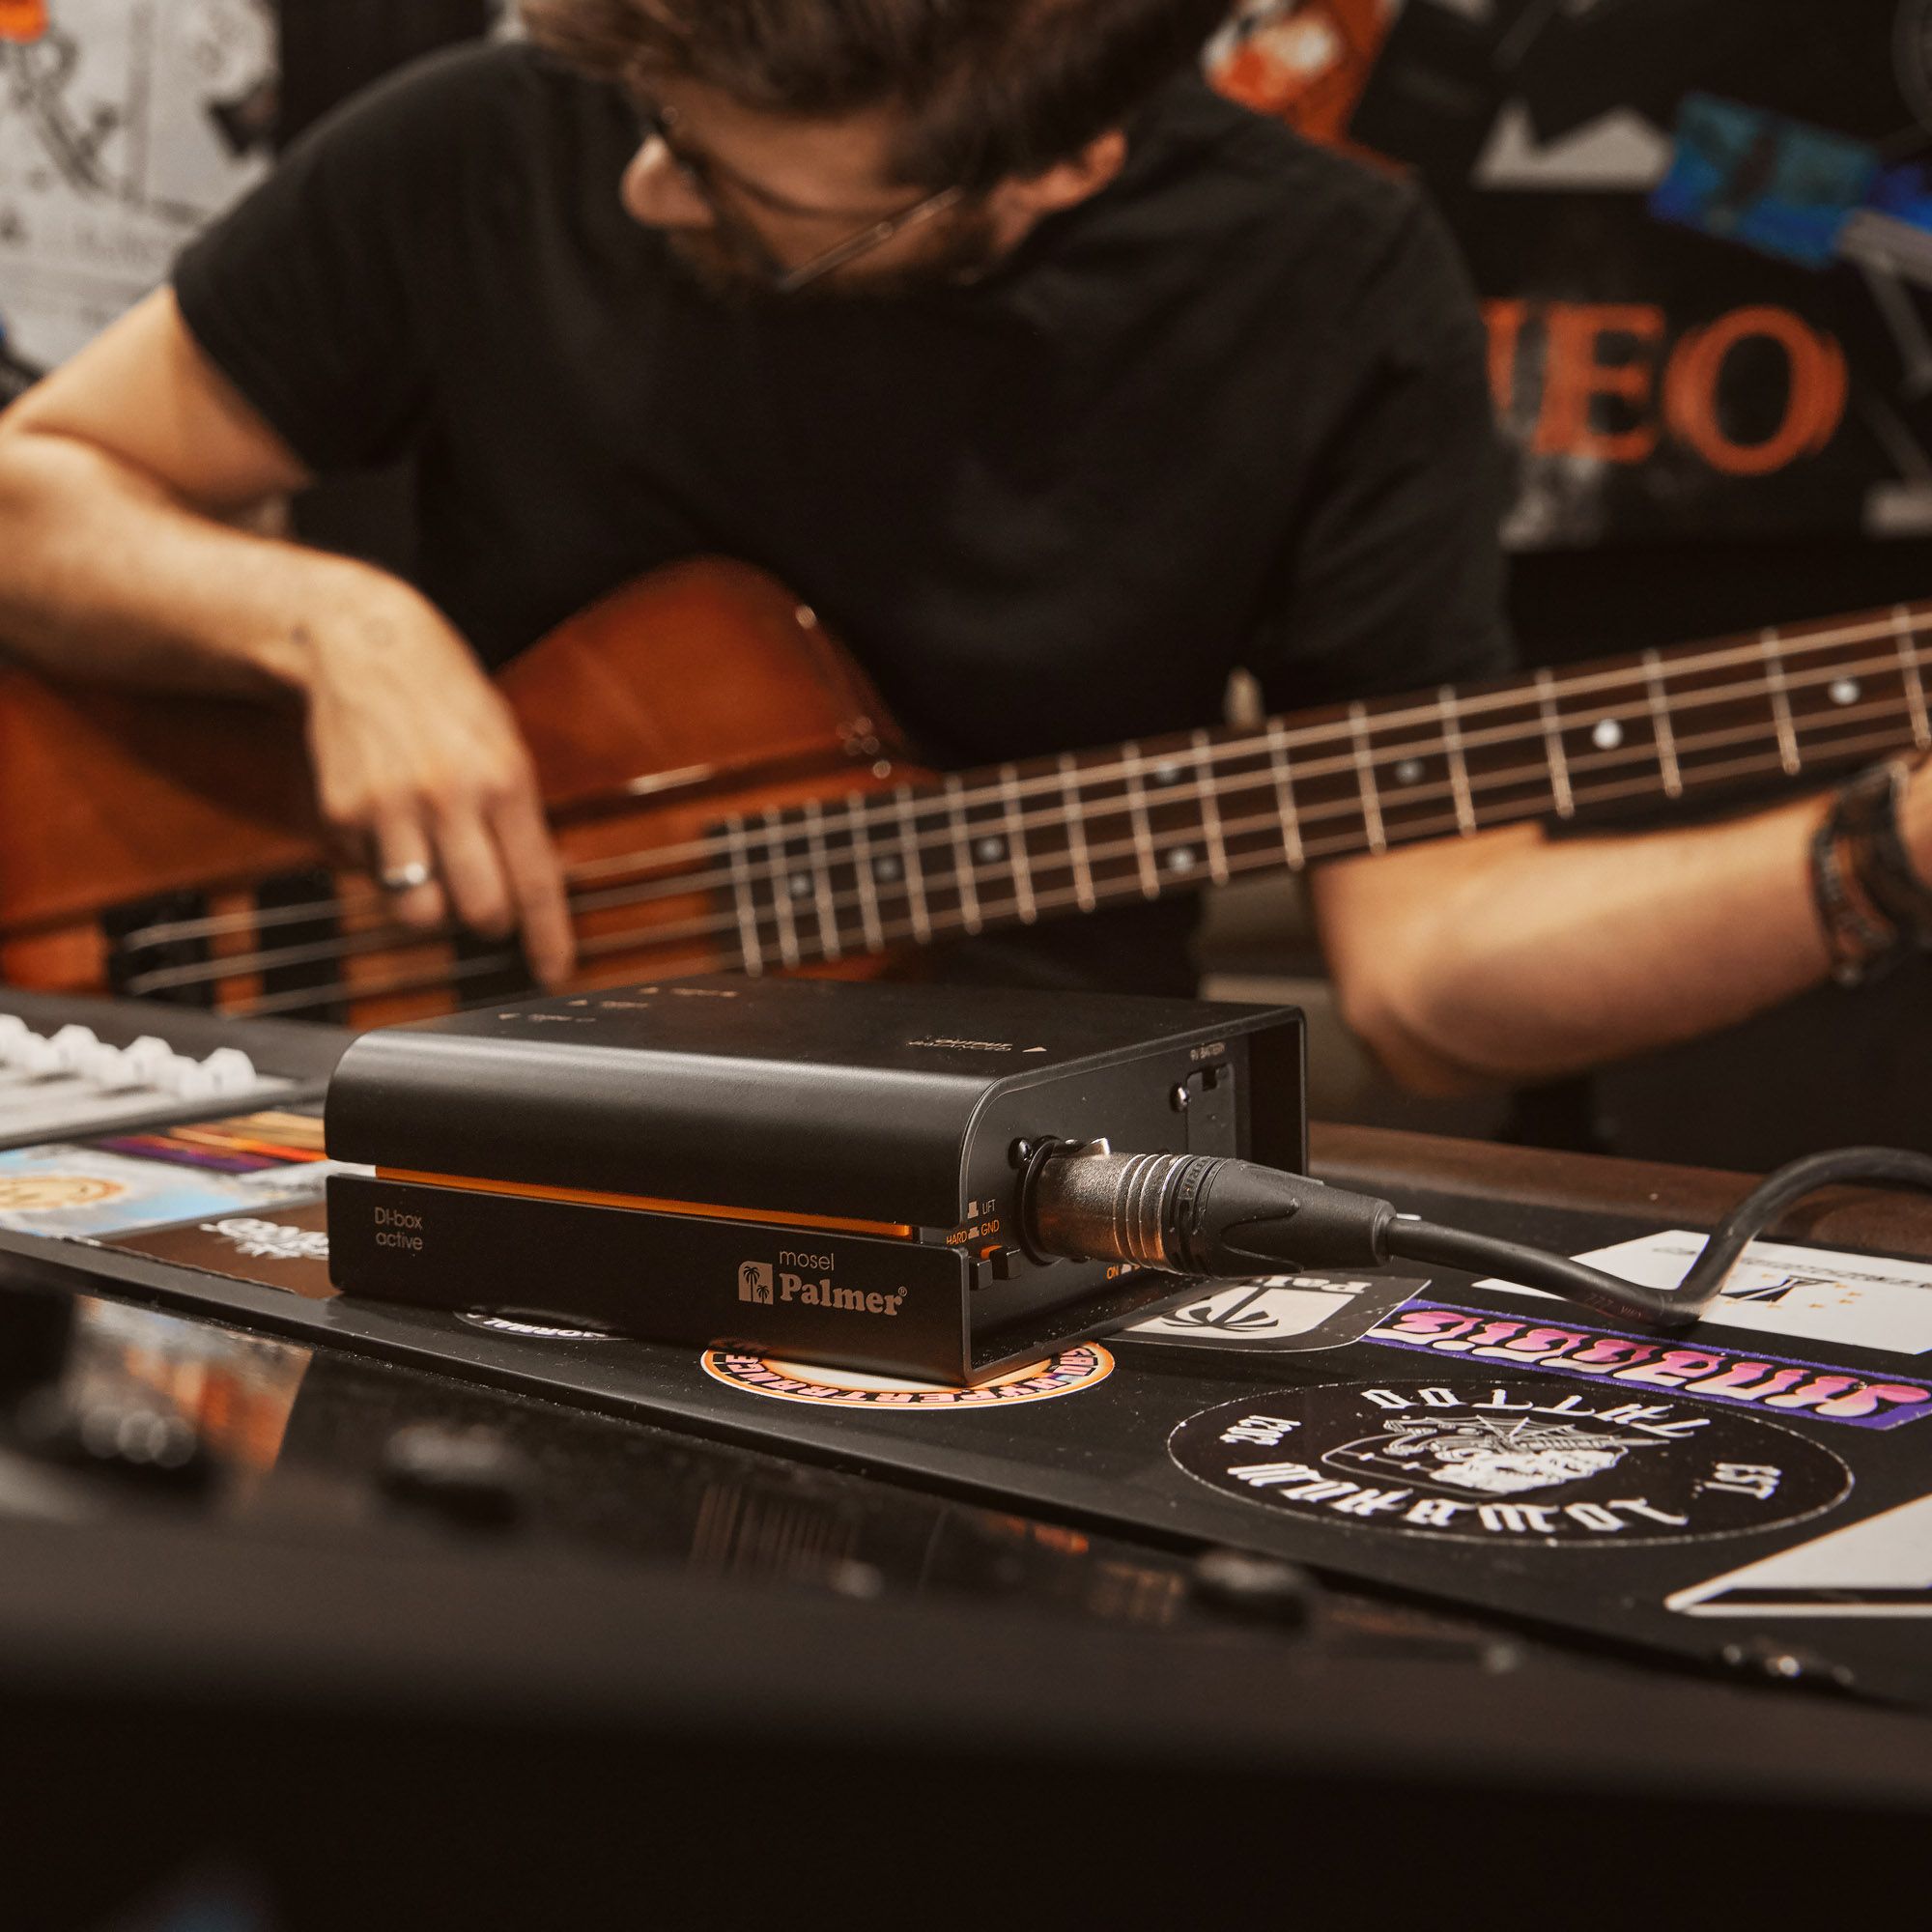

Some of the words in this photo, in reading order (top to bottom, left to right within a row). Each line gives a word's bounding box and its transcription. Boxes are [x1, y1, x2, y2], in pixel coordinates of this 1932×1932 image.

[376, 1232, 423, 1251] active
[946, 1230, 967, 1245] HARD
[980, 1219, 1000, 1236] GND
[779, 1250, 835, 1271] mosel
